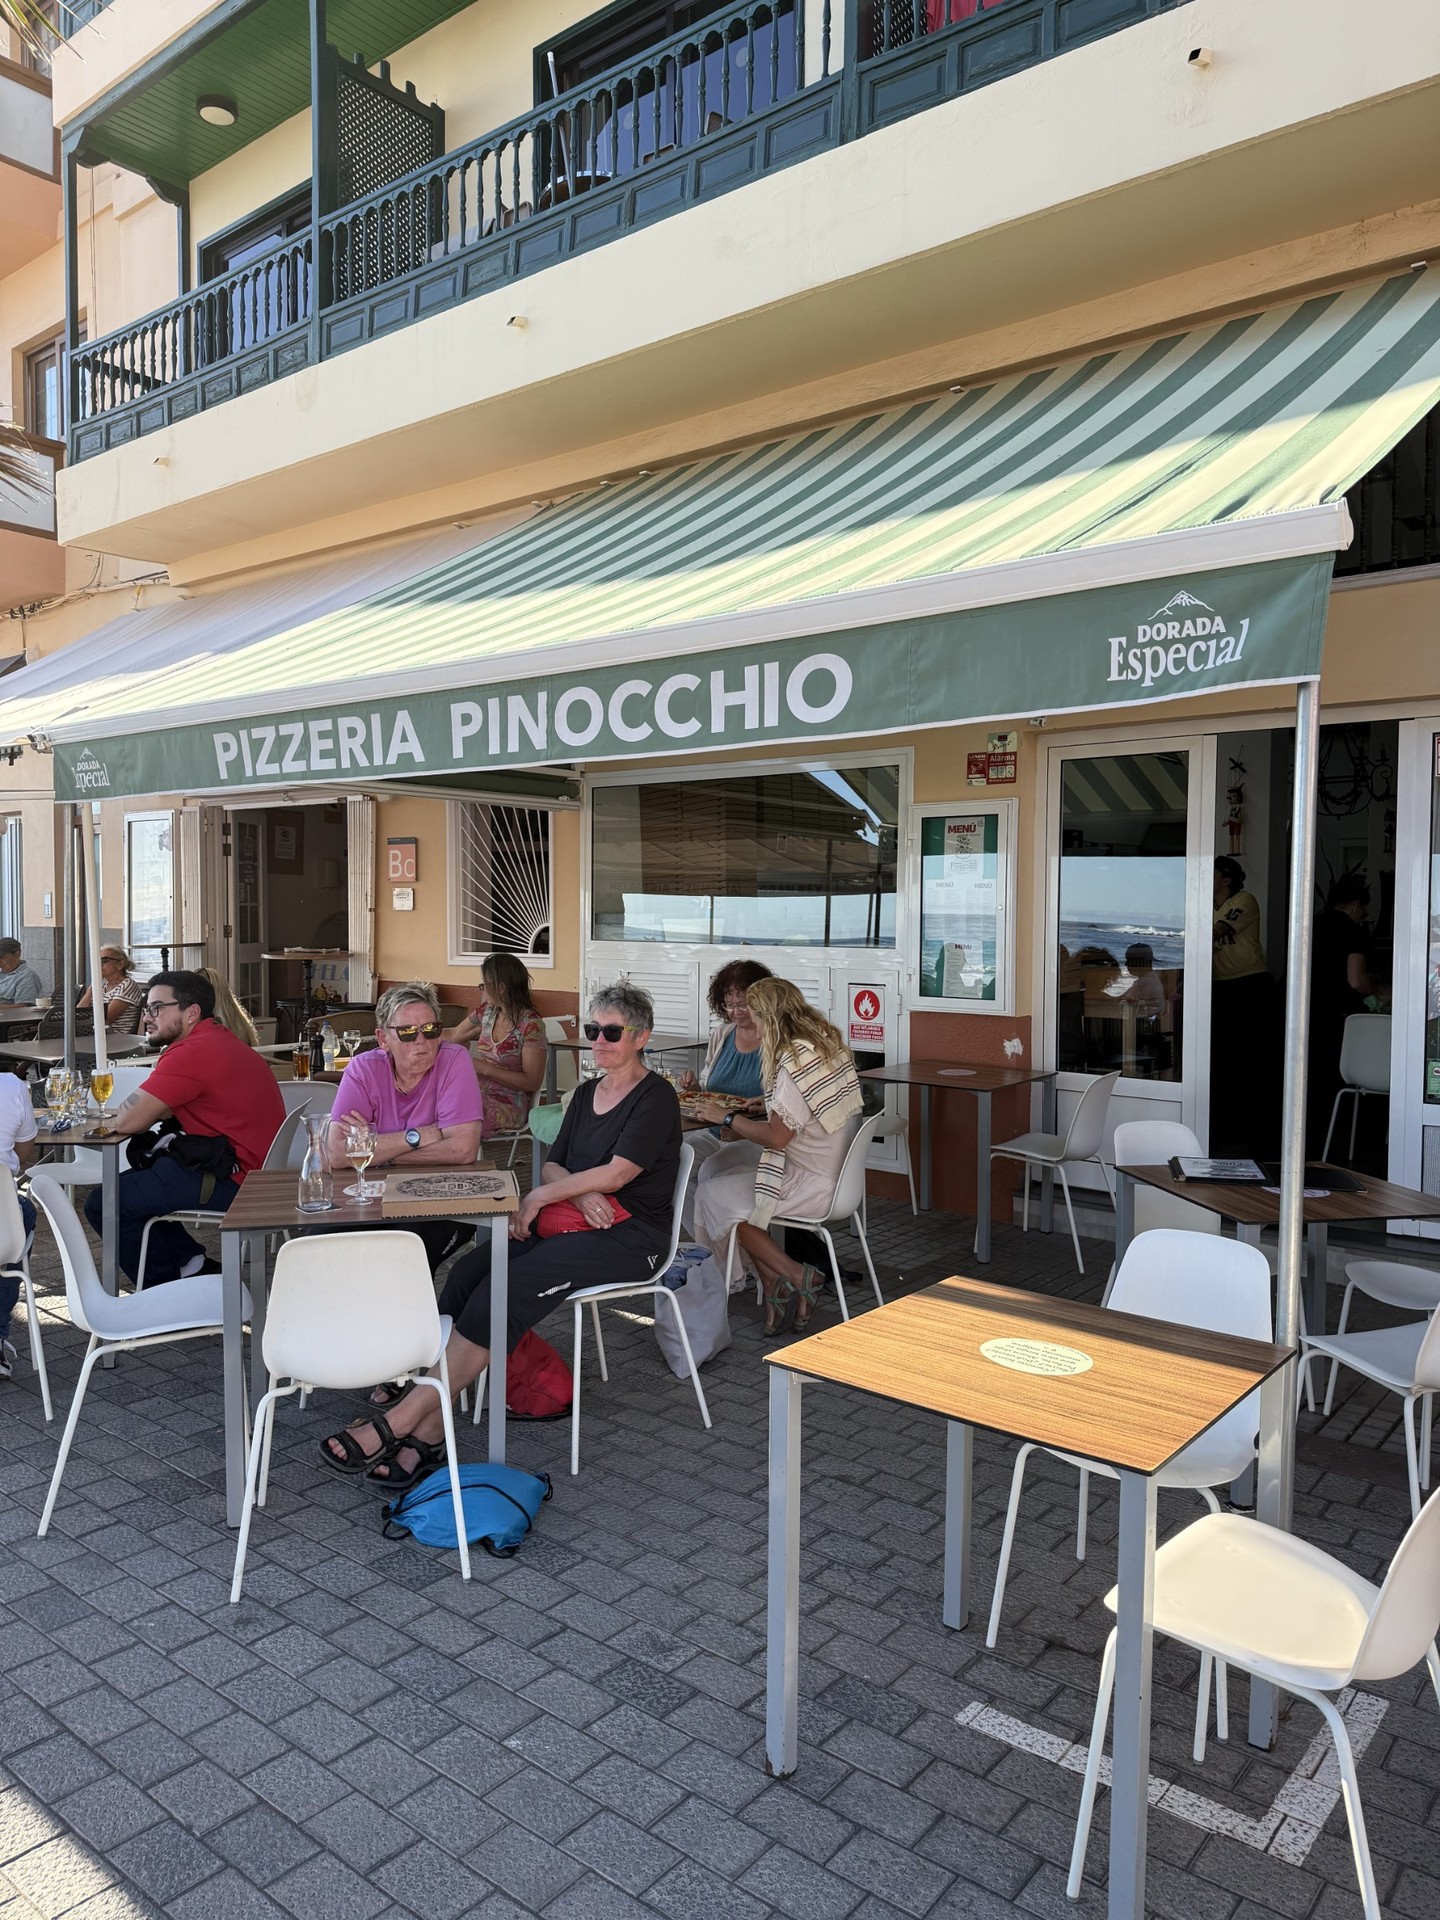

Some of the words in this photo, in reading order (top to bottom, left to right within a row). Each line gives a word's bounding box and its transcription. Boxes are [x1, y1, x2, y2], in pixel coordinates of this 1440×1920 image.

[1137, 616, 1226, 643] DORADA
[1107, 617, 1250, 687] Especial
[212, 709, 426, 780] PIZZERIA
[450, 653, 853, 759] PINOCCHIO
[77, 760, 101, 771] DORADA
[990, 754, 1015, 762] Alarma
[71, 763, 111, 793] pecial
[947, 822, 977, 834] MENÚ
[389, 849, 415, 878] Bc
